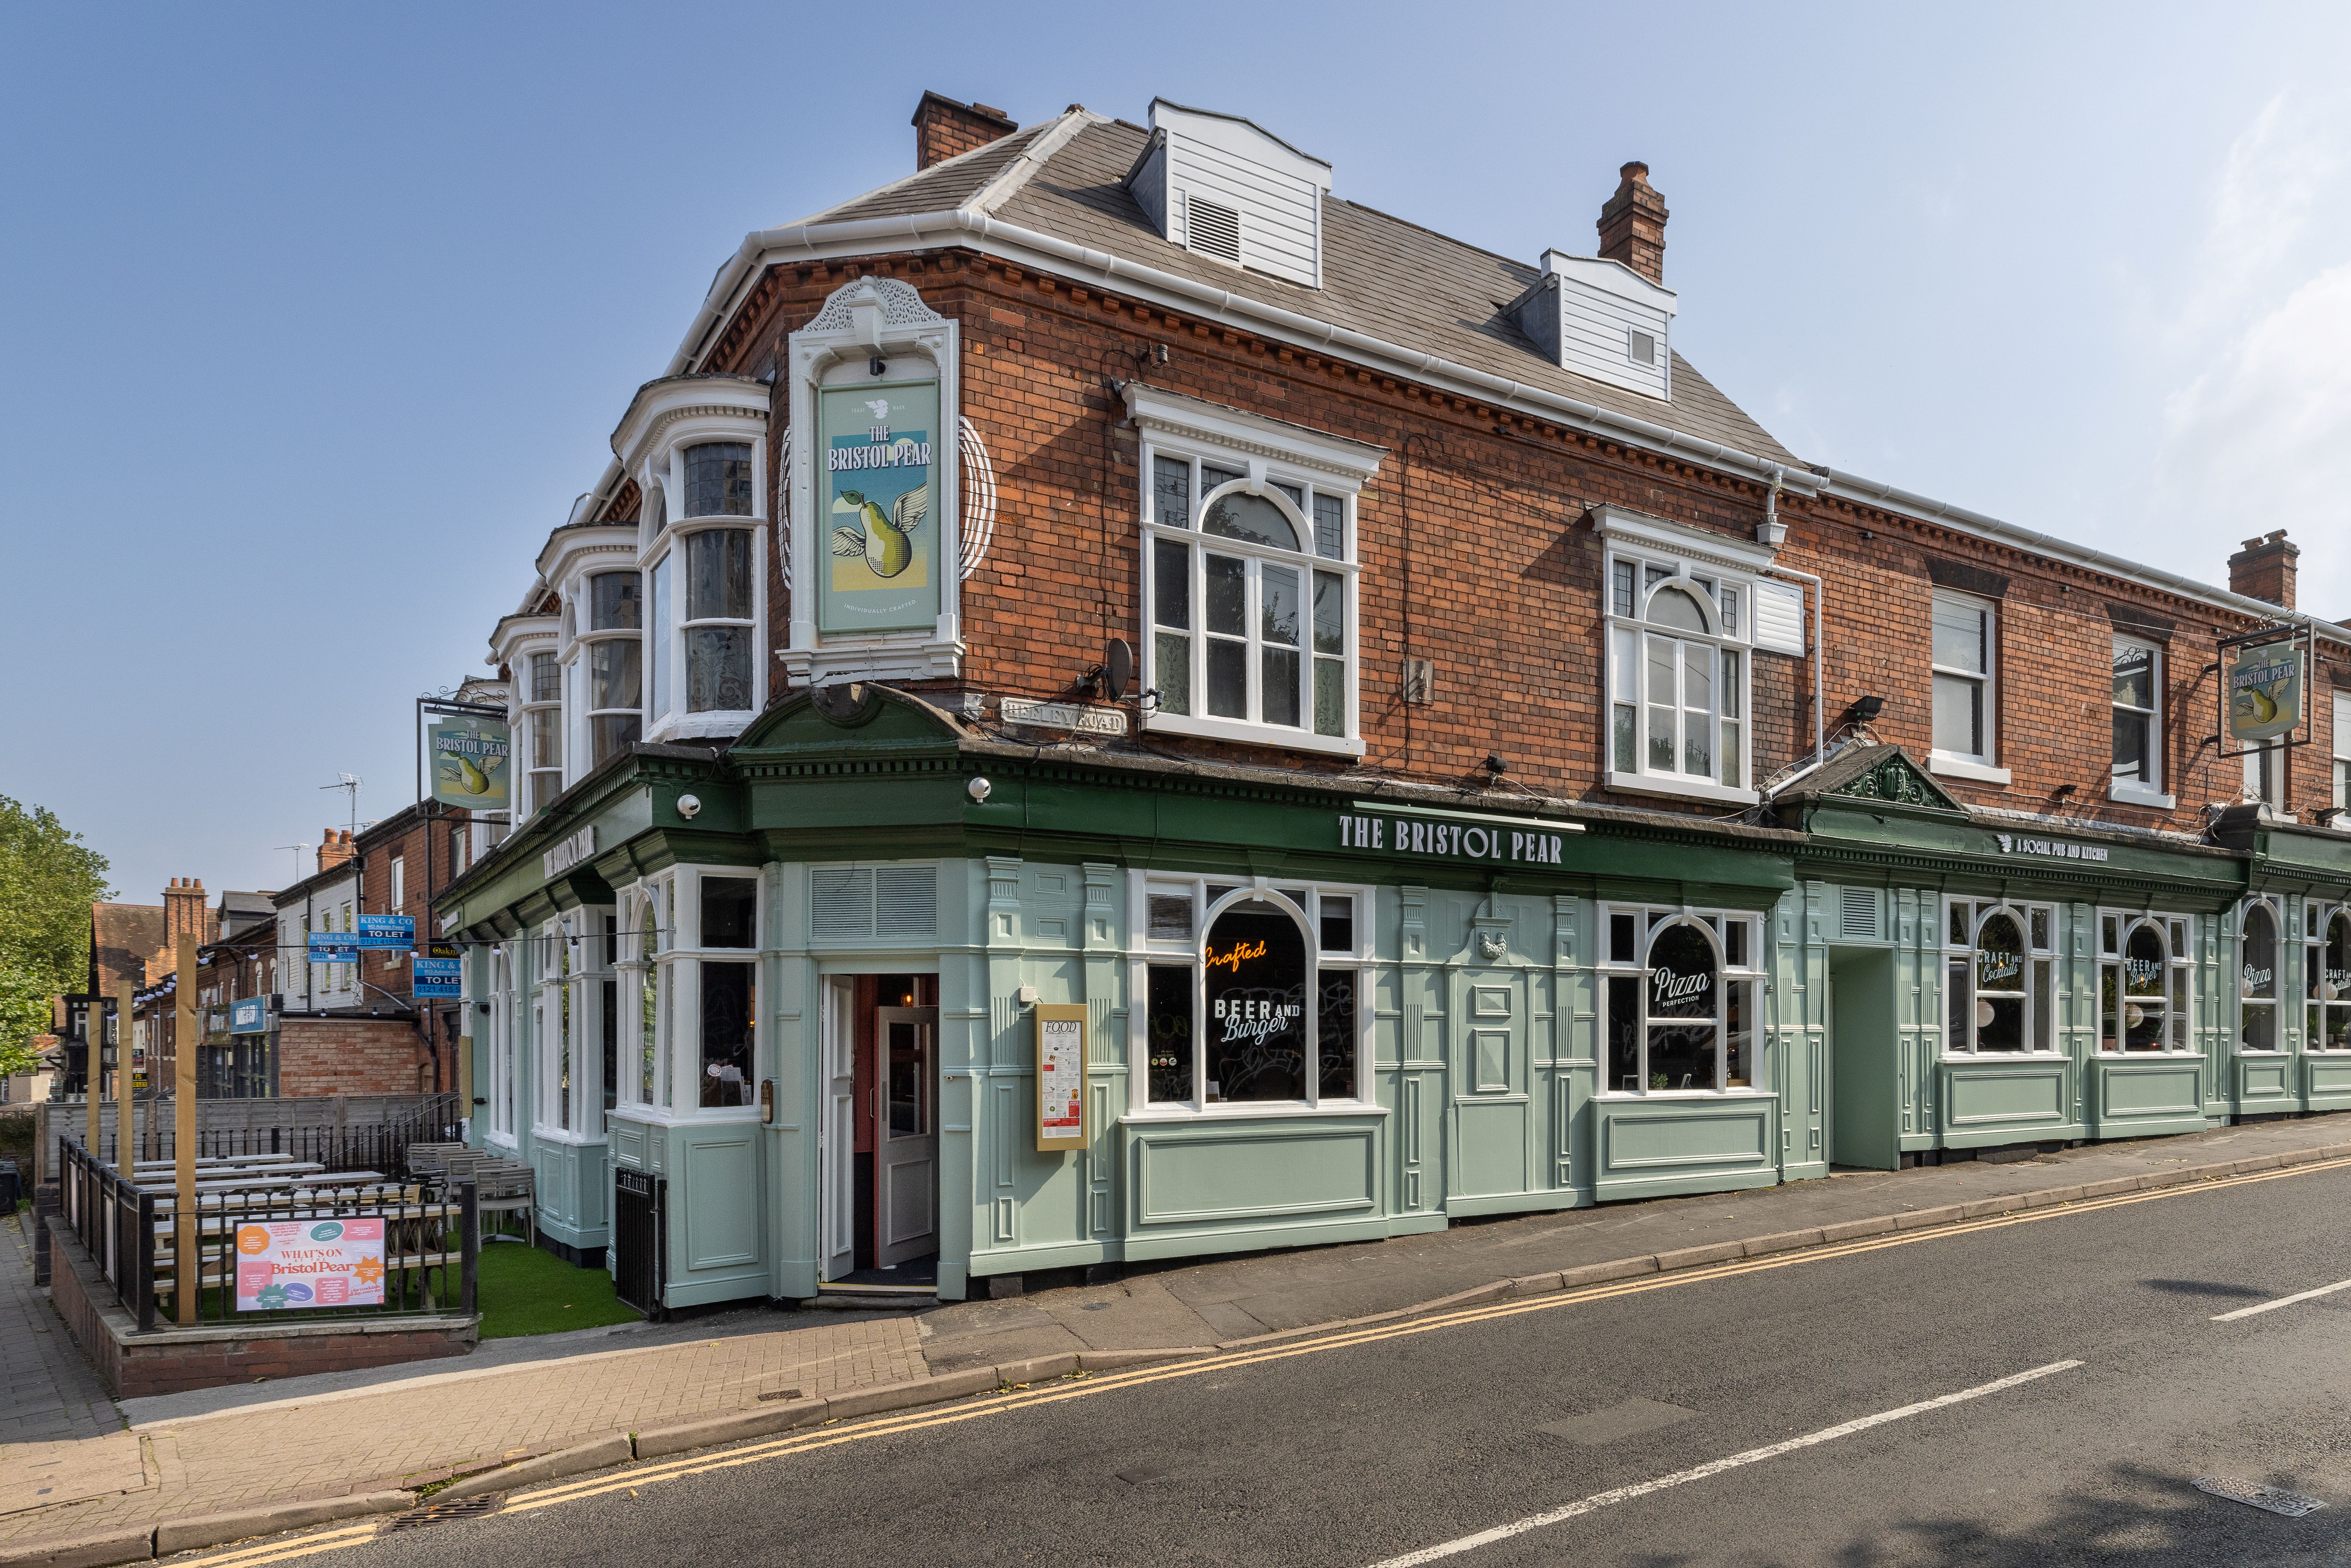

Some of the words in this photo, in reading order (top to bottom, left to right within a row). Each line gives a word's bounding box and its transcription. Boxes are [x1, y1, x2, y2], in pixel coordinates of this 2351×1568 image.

[869, 425, 889, 442] THE
[828, 445, 889, 471] BRISTOL
[893, 442, 932, 467] PEAR
[844, 603, 886, 613] INDIVIDUALLY
[889, 600, 916, 612] CRAFTED
[2258, 659, 2270, 669] THE
[2233, 670, 2269, 689] BRISTOL
[2272, 664, 2295, 680] PEAR
[1007, 704, 1074, 724] HEELEY
[1078, 713, 1121, 731] ROAD
[466, 730, 480, 739] THE
[436, 737, 480, 754] BRISTOL
[483, 742, 509, 757] PEAR
[1339, 816, 1383, 849] THE
[1395, 821, 1500, 859] BRISTOL
[1511, 832, 1562, 864] PEAR
[2016, 839, 2022, 852] A
[2024, 839, 2051, 855] SOCIAL
[2052, 842, 2066, 856] PUB
[2066, 844, 2080, 858] AND
[2081, 846, 2108, 861] KITCHEN
[1205, 940, 1266, 972] Crafted
[1978, 951, 2010, 964] CRAFT
[2127, 959, 2150, 972] BEER
[1983, 960, 2019, 982] Cocktails
[2130, 968, 2157, 988] Burger
[2244, 964, 2272, 988] Pizza
[2325, 969, 2346, 979] CRAFT
[1655, 967, 1710, 1002] Pizza
[1215, 999, 1271, 1019] BEER
[1275, 1004, 1300, 1016] AND
[1662, 995, 1699, 1008] PERFECTION
[1045, 1021, 1077, 1032] FOOD
[1220, 1014, 1288, 1045] Burger
[281, 1249, 324, 1259] WHAT'S
[326, 1249, 343, 1257] ON
[270, 1262, 317, 1275] Bristol
[319, 1261, 353, 1273] Pear
